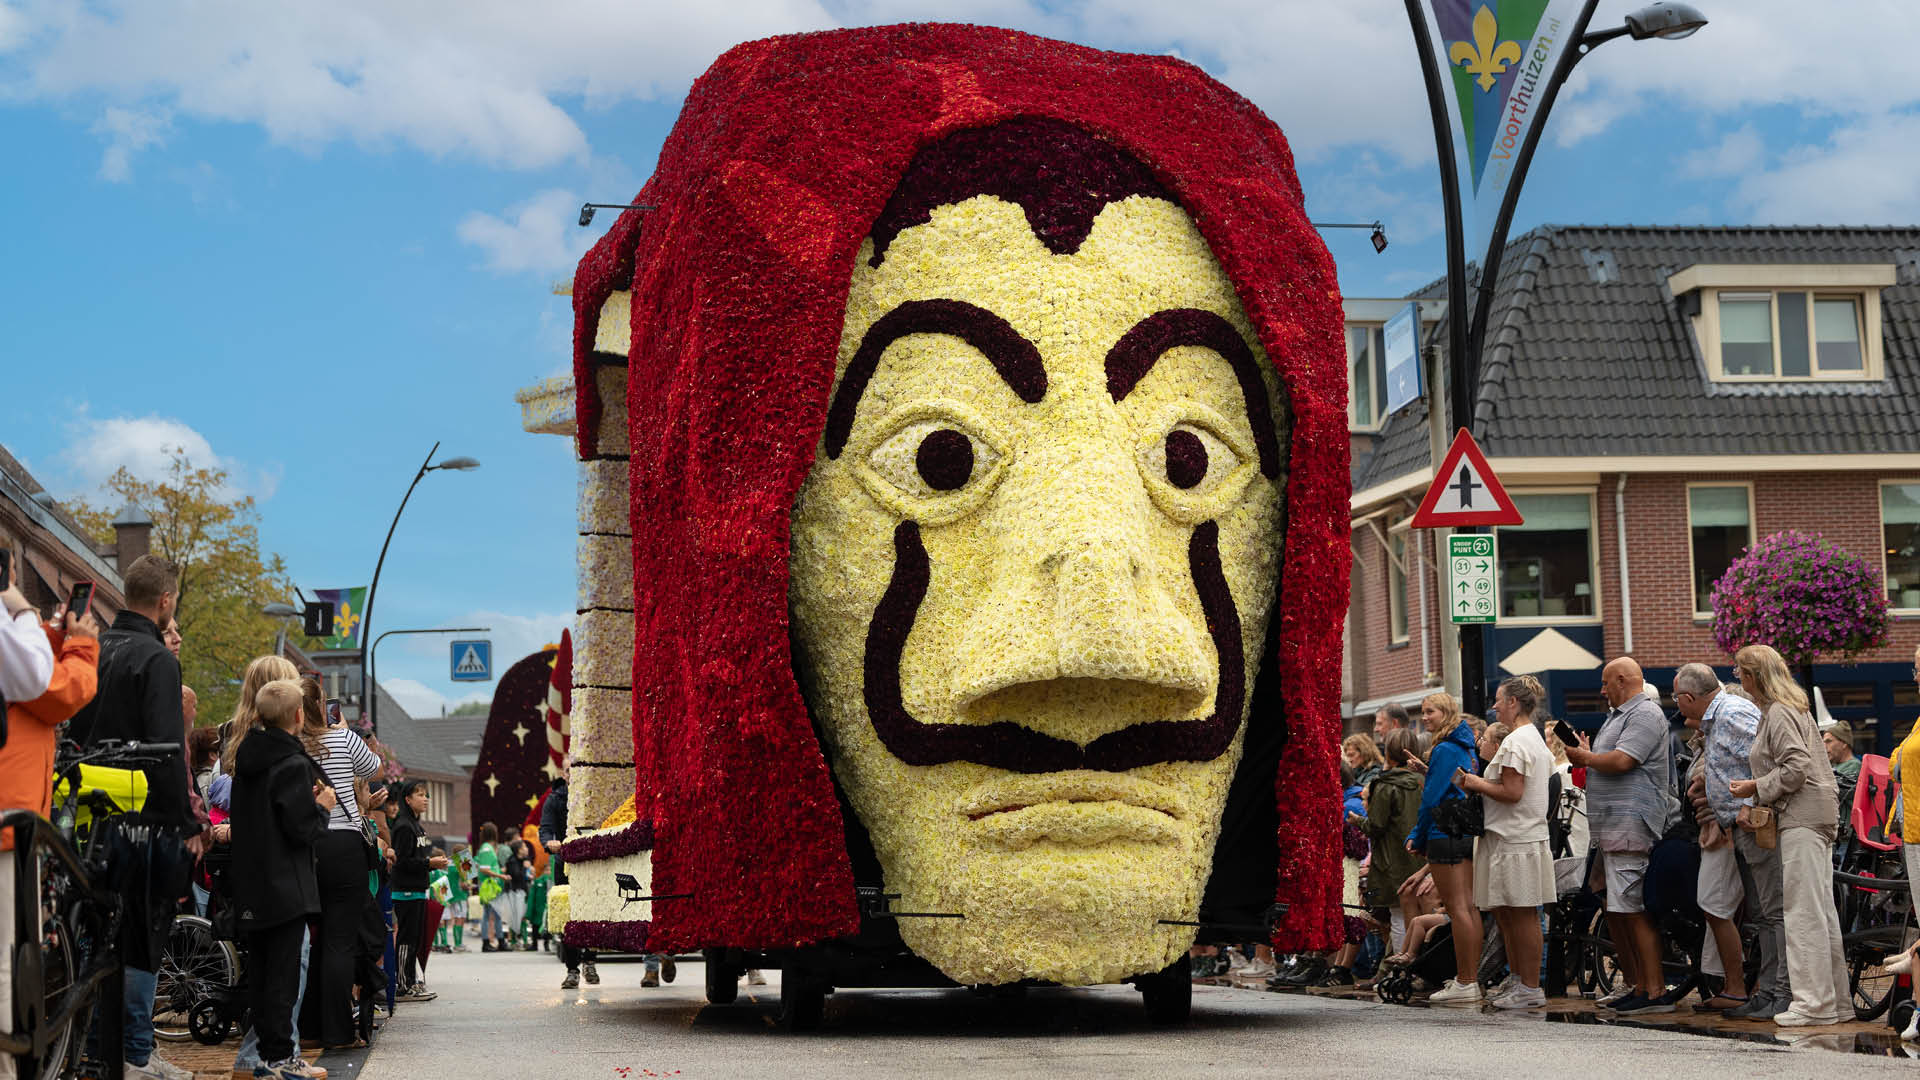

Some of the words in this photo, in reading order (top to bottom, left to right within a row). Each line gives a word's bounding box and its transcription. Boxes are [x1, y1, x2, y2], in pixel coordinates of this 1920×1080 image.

[1475, 542, 1487, 551] 21
[1457, 562, 1468, 570] 31
[1478, 602, 1489, 610] 95
